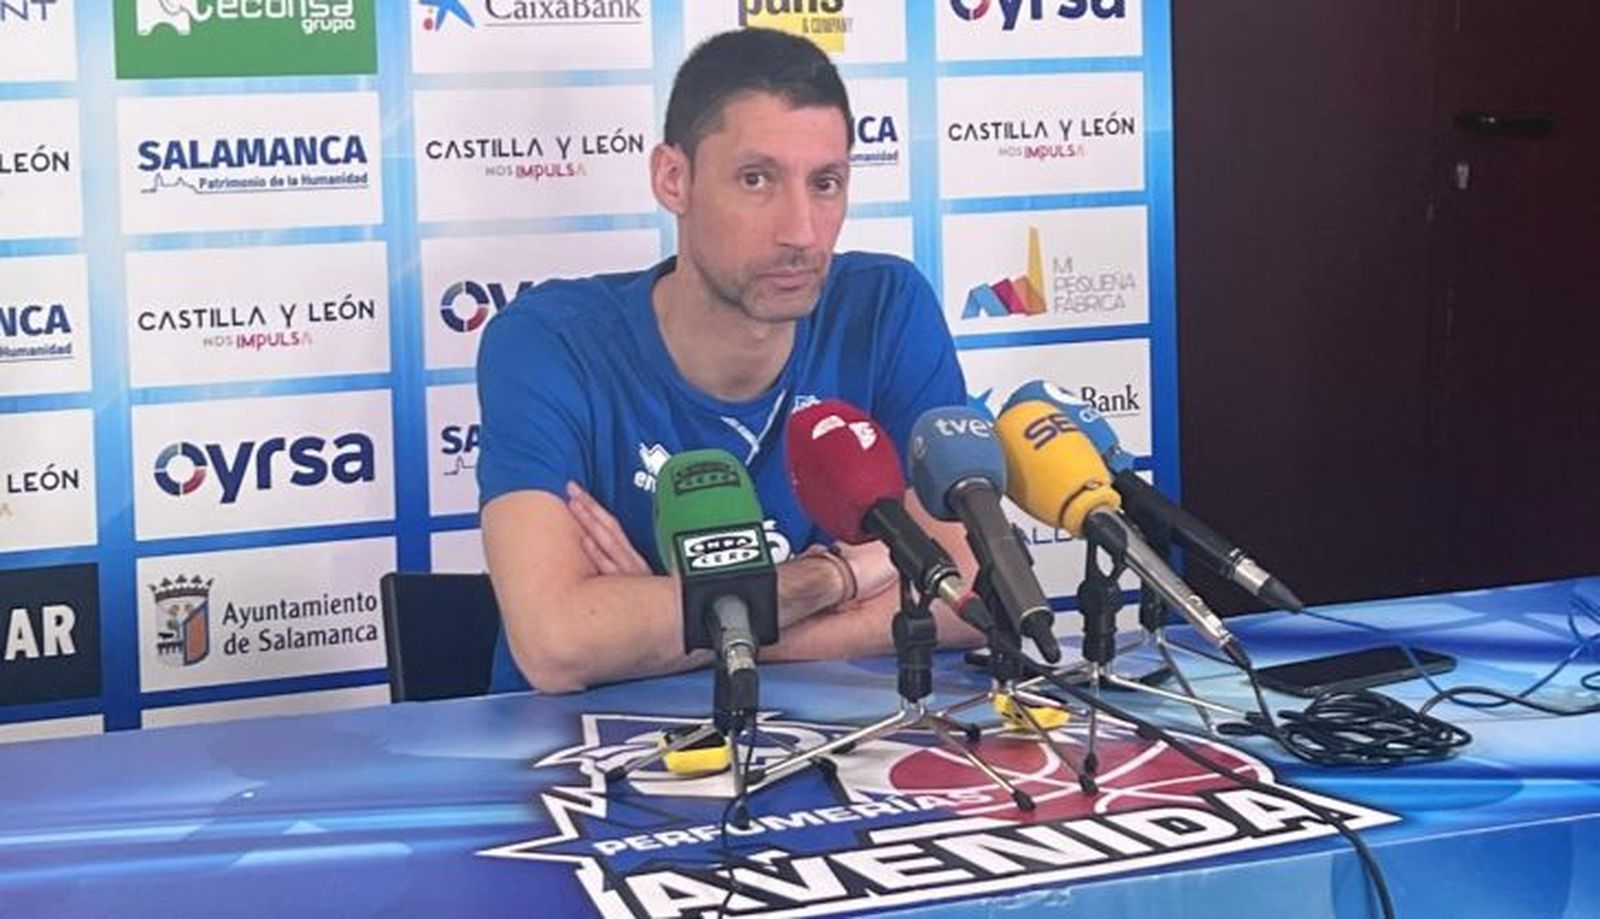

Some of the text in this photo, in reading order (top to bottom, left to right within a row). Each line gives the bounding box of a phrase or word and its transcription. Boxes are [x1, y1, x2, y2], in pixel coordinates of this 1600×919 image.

[485, 0, 642, 19] CaixaBank
[851, 115, 898, 144] CA
[948, 111, 1135, 142] CASTILLA Y LEÓN
[138, 135, 368, 171] SALAMANCA
[425, 127, 644, 160] CASTILLA Y LEÓN
[1024, 144, 1085, 161] IMPULSA
[0, 144, 70, 174] LEÓN
[485, 161, 587, 181] NOS IMPULSA
[199, 172, 368, 189] Patrimonio de la Humanidad
[138, 293, 375, 331] CASTILLA Y LEÓN
[203, 331, 313, 351] NOS IMPULSA
[935, 418, 991, 438] tve
[7, 463, 79, 493] LEÓN
[222, 591, 378, 630] Ayuntamiento
[4, 604, 77, 661] AR
[223, 623, 378, 656] de Salamanca
[625, 788, 1332, 919] AVENIDA
